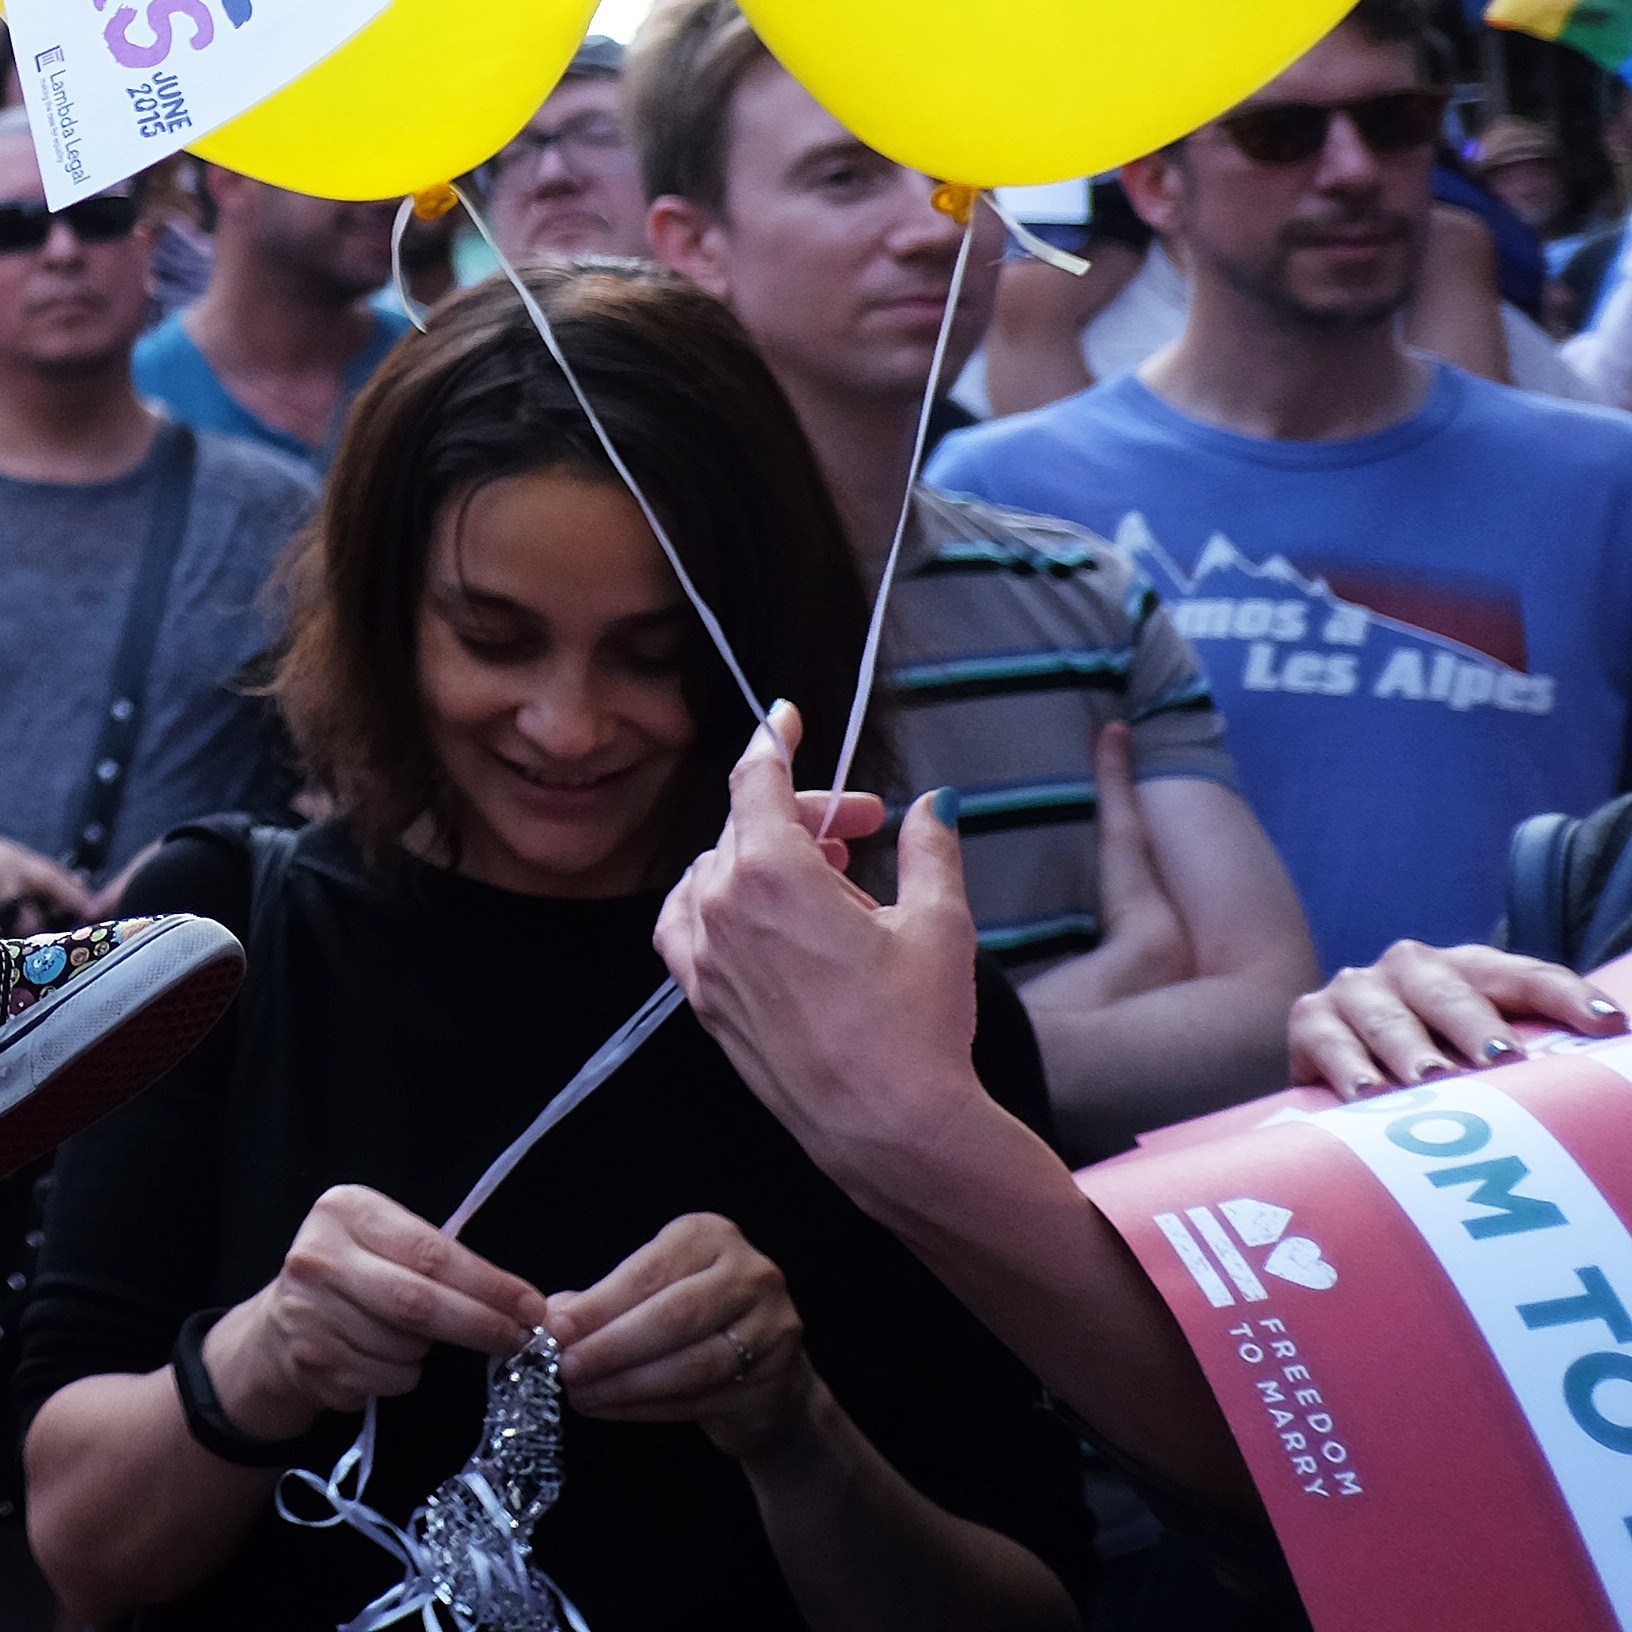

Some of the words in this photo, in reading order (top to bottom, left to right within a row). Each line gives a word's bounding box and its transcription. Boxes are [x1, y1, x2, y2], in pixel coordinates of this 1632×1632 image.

[49, 69, 79, 139] Lambda
[64, 137, 91, 186] Legal
[125, 83, 166, 139] 2015
[151, 71, 193, 134] JUNE
[1170, 597, 1311, 642] mos
[1241, 640, 1359, 697] Les
[1372, 647, 1557, 716] Alpes
[1229, 1322, 1264, 1364] TO
[1256, 1380, 1331, 1498] MARRY
[1258, 1317, 1364, 1496] FREEDOM
